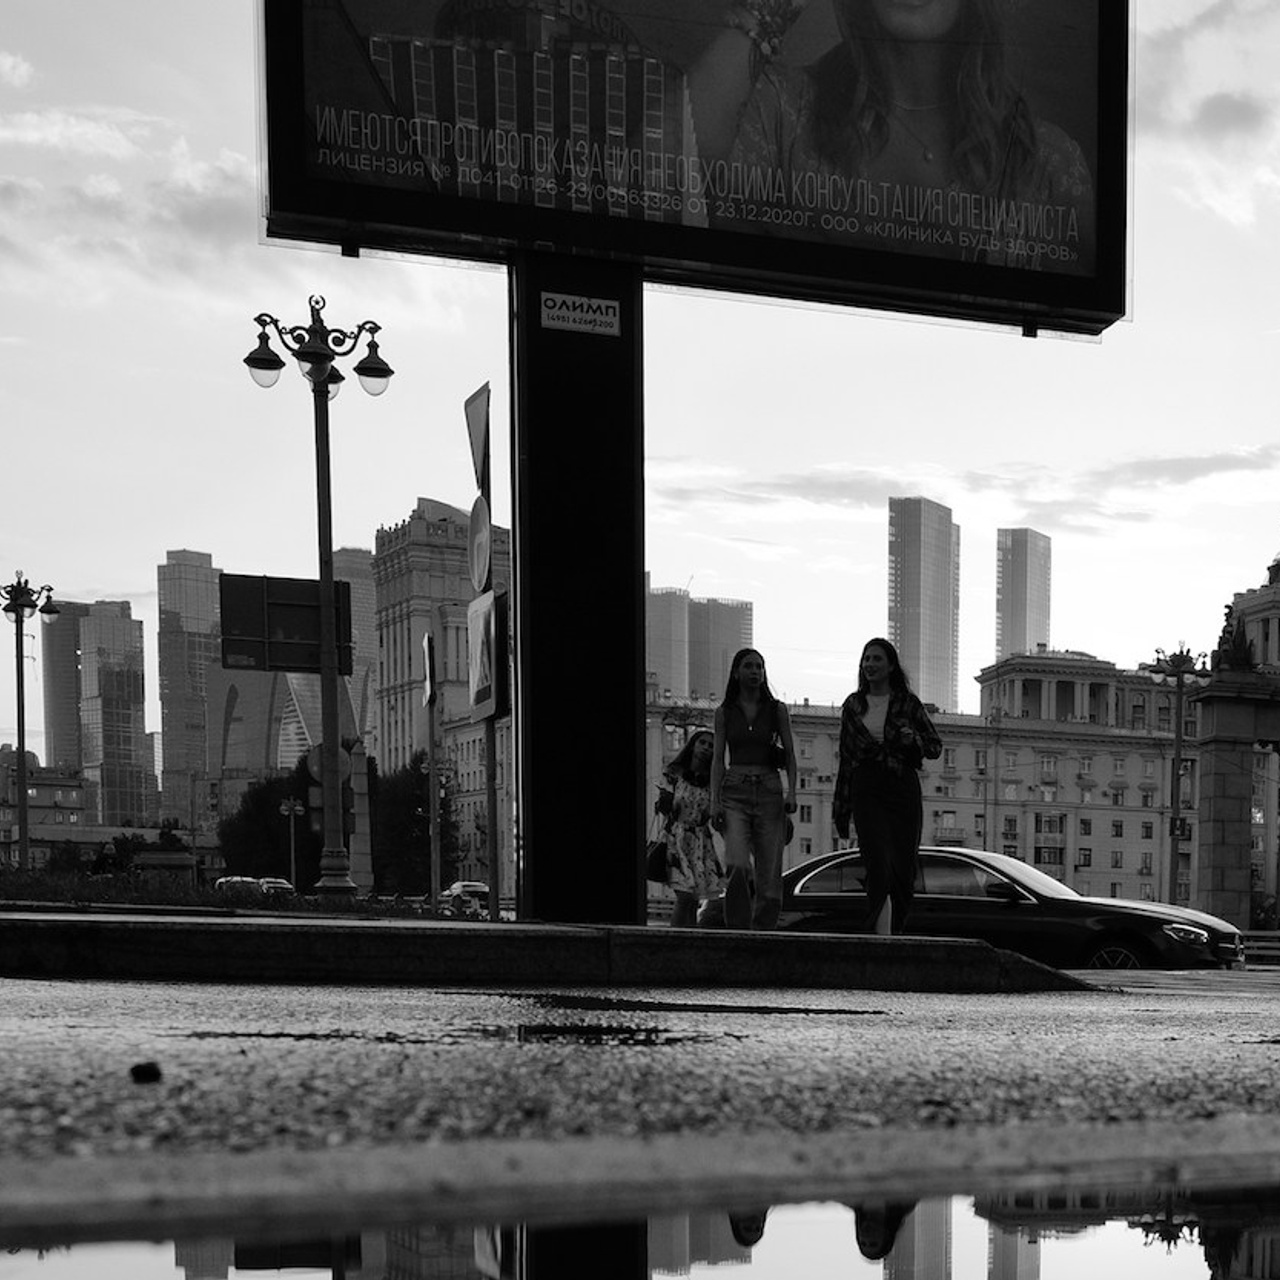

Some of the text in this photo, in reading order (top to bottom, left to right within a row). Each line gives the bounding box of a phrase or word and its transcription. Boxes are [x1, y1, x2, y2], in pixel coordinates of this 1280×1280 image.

[316, 104, 421, 155] ИМЕЮТСЯ
[649, 152, 786, 204] НЕОБХОДИМА
[791, 171, 943, 225] КОНСУЛЬТАЦИЯ
[947, 189, 1081, 242] СПЕЦИАЛИСТА
[316, 148, 426, 177] ЛИЦЕНЗИЯ
[687, 197, 710, 215] ОТ
[820, 214, 860, 234] ООО
[864, 223, 955, 246] «КЛИНИКА
[958, 231, 1001, 253] БУДЬ
[1004, 237, 1080, 263] ЗДОРОВ»
[544, 298, 616, 317] ОЛИМП
